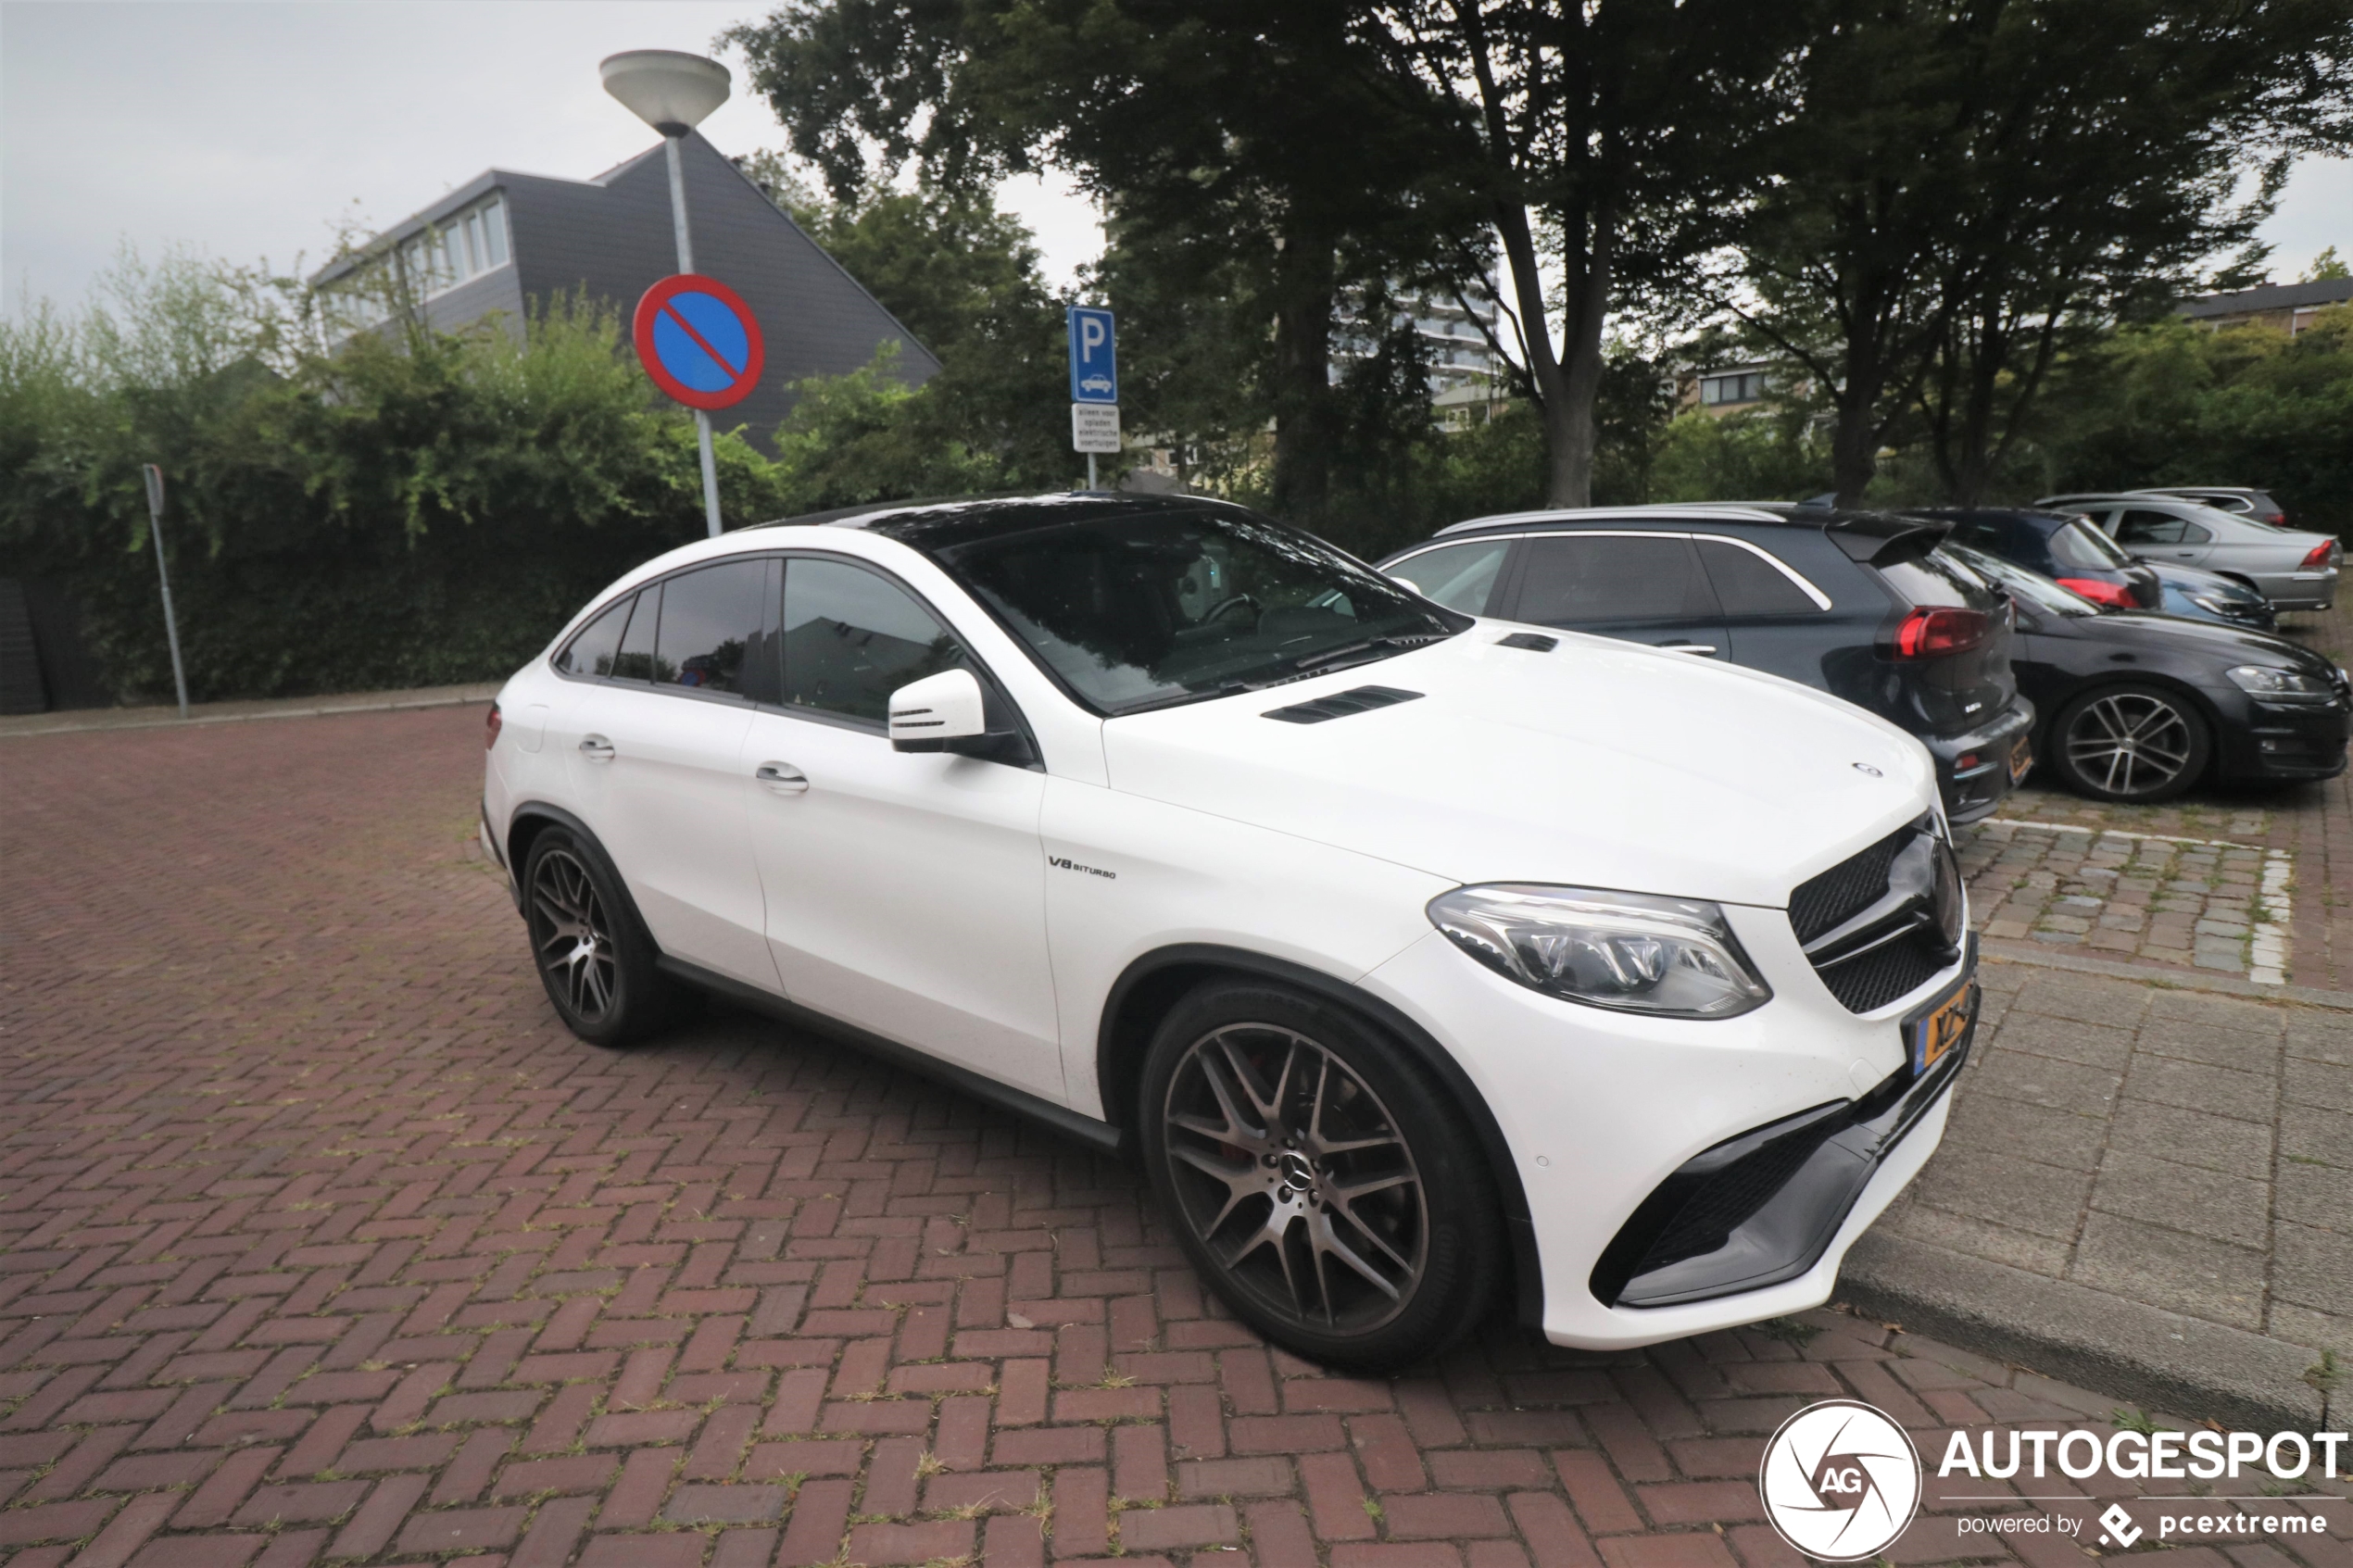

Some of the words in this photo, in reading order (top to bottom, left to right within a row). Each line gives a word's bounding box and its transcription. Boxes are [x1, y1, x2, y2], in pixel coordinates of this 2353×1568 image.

[1081, 316, 1105, 364] P
[1048, 855, 1072, 870] V8
[1073, 863, 1116, 880] BITURBO
